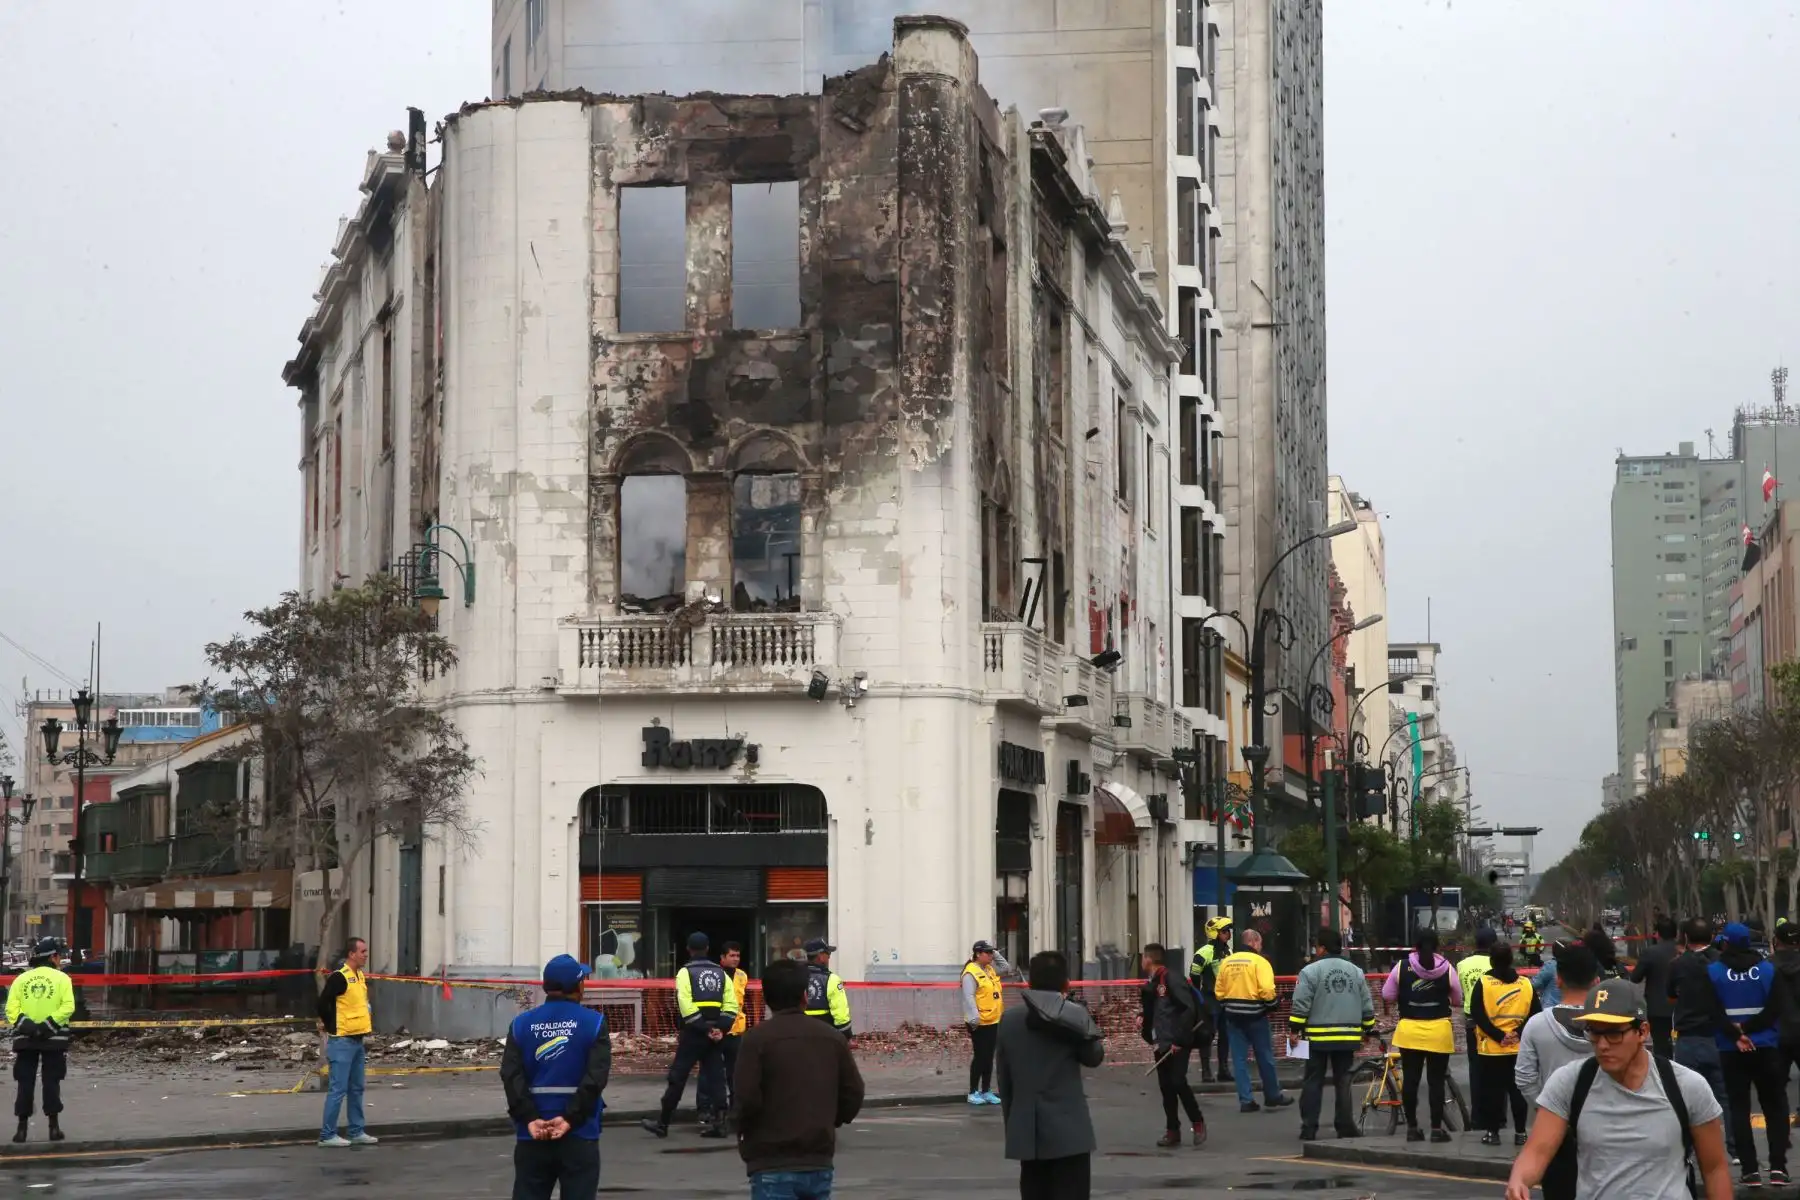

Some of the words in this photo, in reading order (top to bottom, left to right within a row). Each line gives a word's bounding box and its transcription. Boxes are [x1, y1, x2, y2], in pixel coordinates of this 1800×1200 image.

[1594, 990, 1608, 1008] P
[530, 1019, 577, 1031] FISCALIZACIÓN
[542, 1028, 573, 1038] CONTROL
